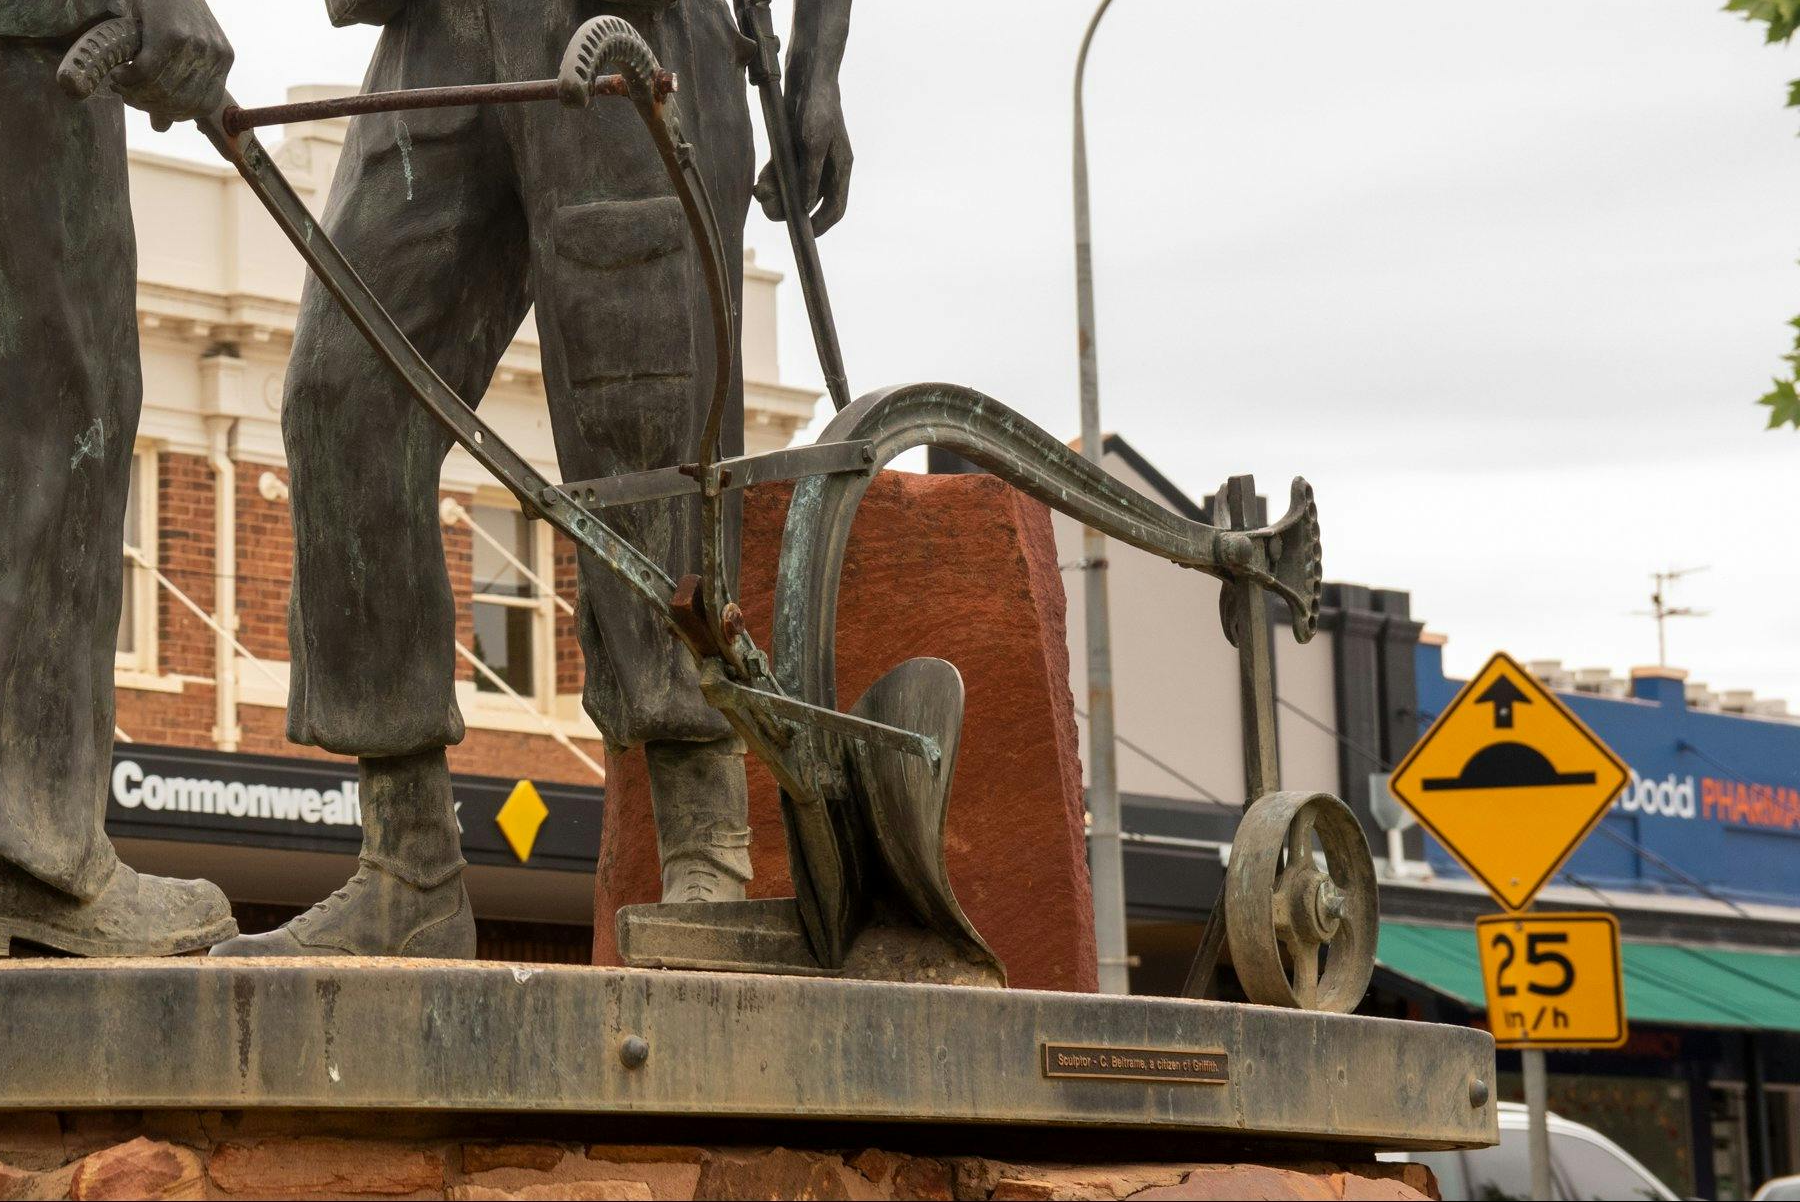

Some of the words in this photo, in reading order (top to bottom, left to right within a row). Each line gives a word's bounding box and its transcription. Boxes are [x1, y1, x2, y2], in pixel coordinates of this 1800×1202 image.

[112, 760, 362, 826] Commonwealt
[1621, 768, 1696, 819] Dodd
[1492, 933, 1574, 996] 25
[1057, 1053, 1091, 1069] Sculptor
[1100, 1055, 1109, 1068] C.
[1149, 1059, 1155, 1069] a
[1157, 1058, 1181, 1070] citizen
